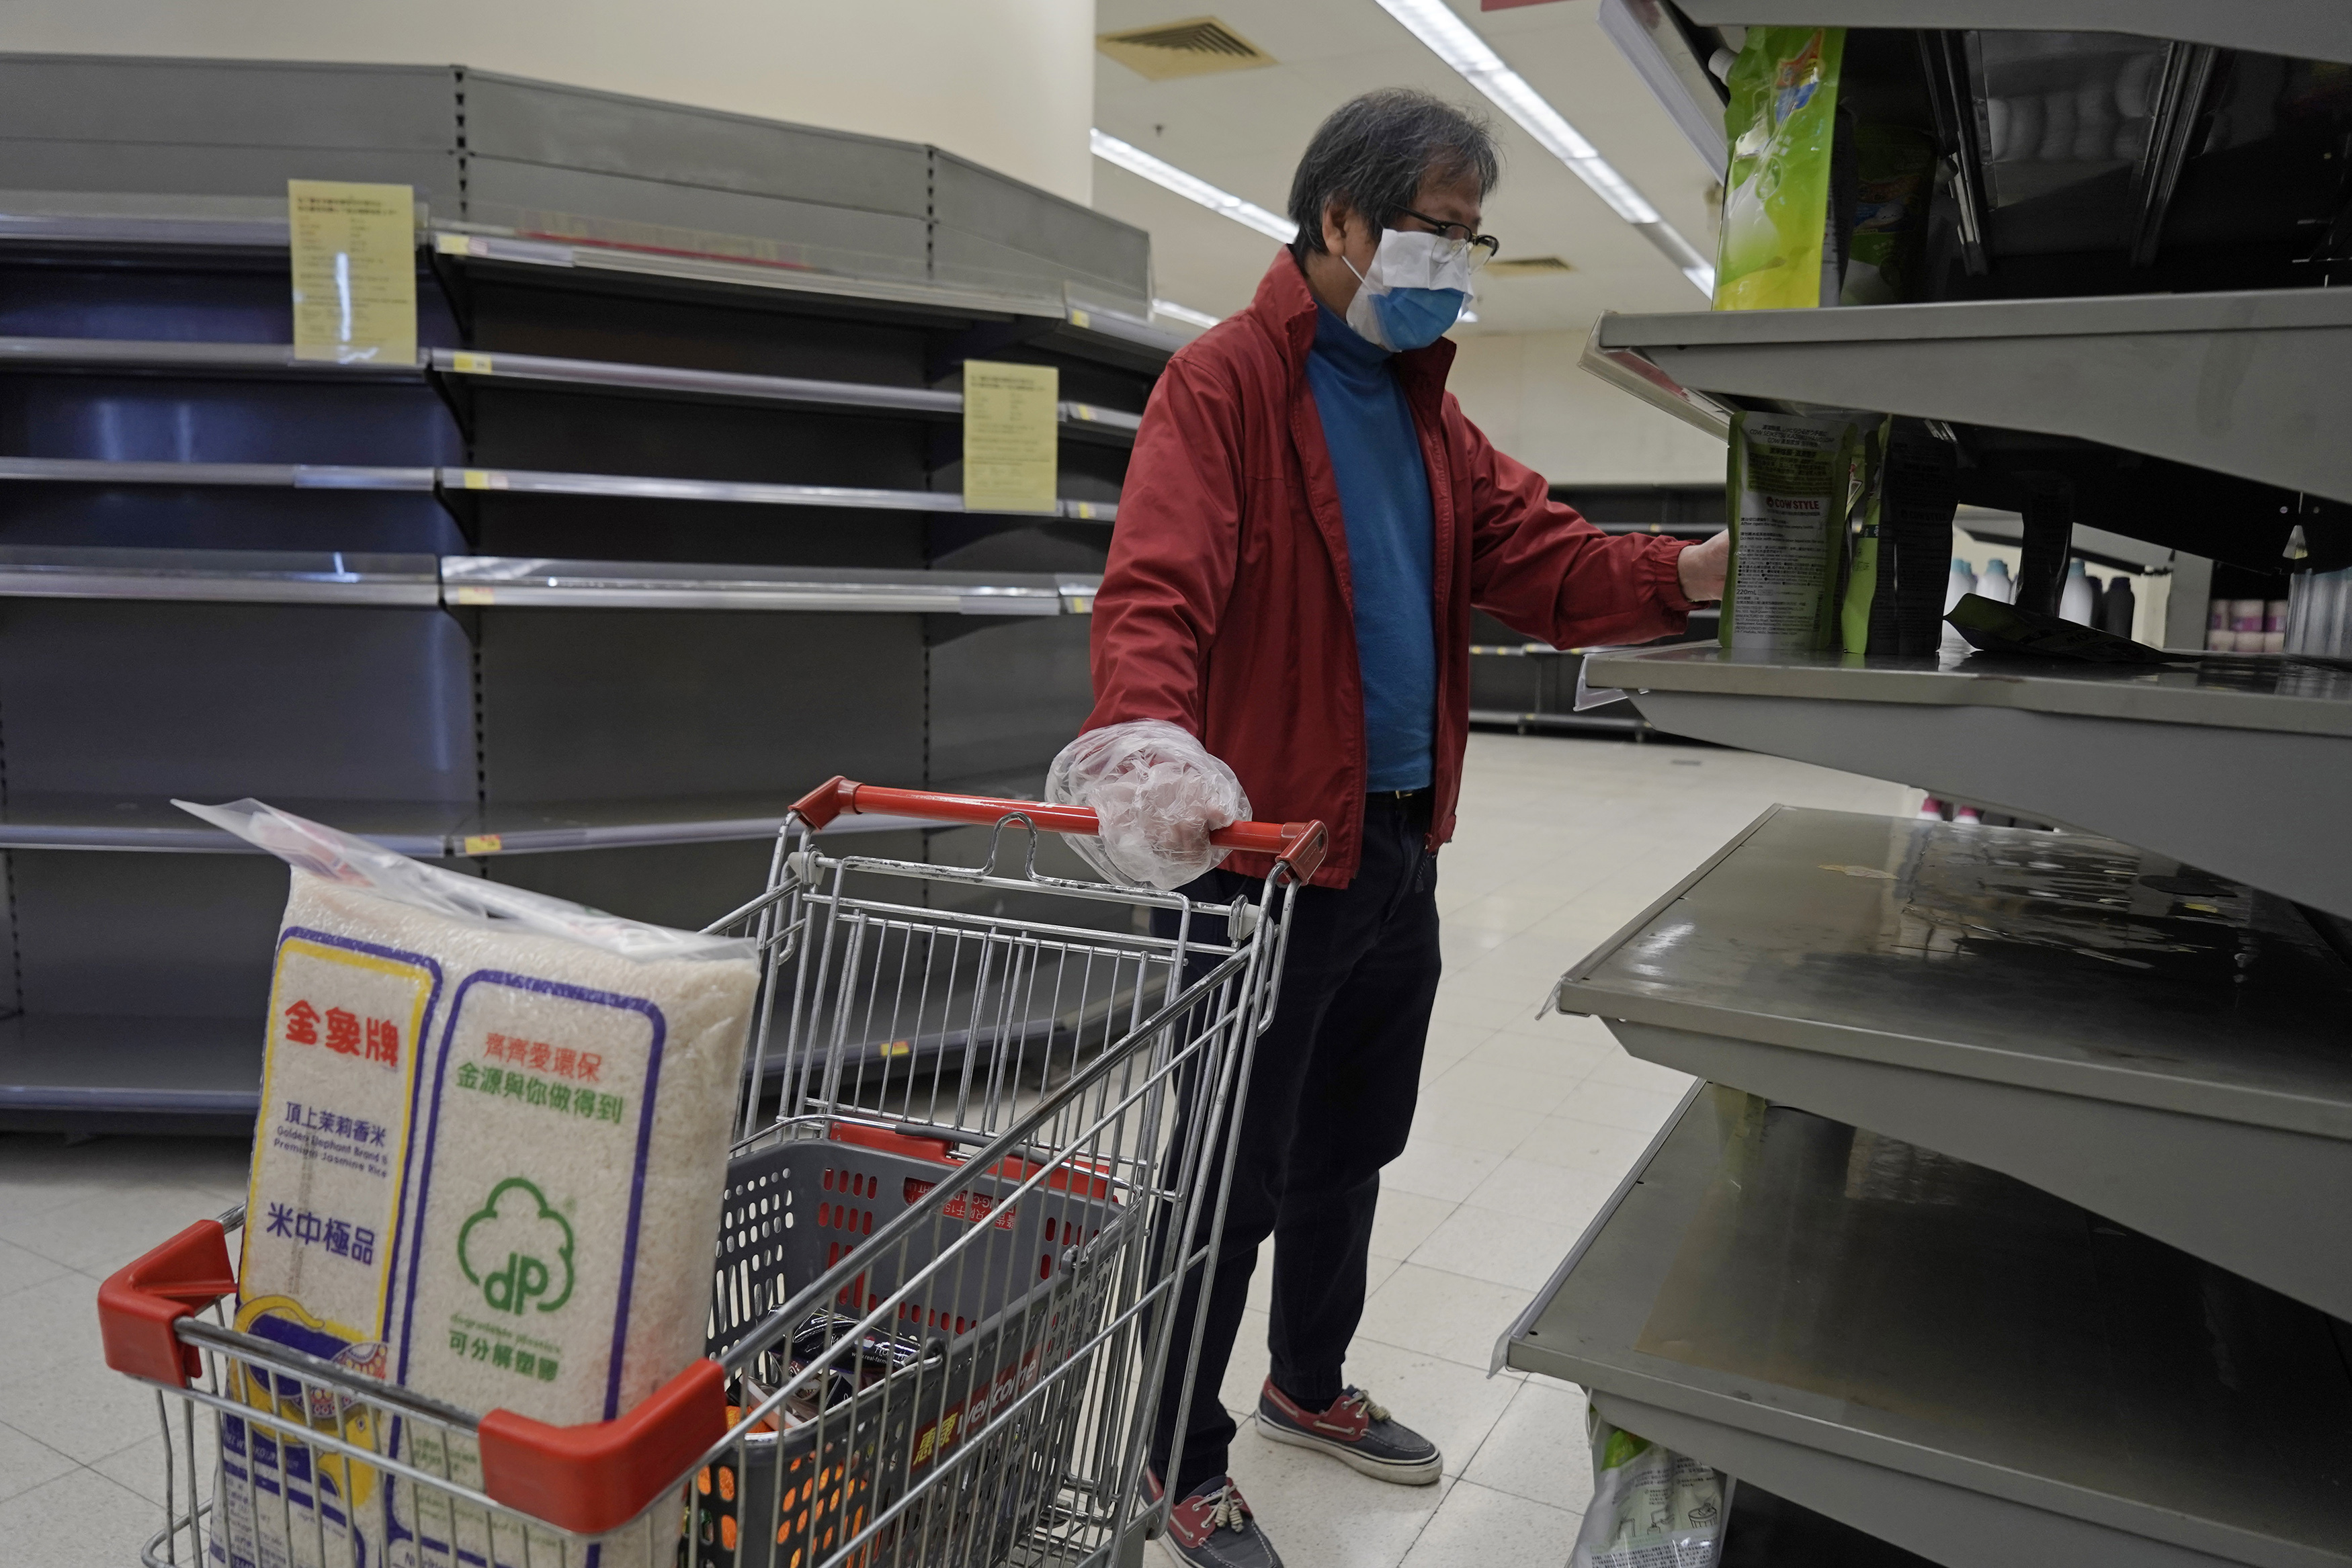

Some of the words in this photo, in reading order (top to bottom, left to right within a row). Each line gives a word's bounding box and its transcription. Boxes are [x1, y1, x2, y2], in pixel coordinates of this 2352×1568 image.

[1775, 498, 1792, 509] COW
[1793, 500, 1819, 510] STYLE
[277, 1126, 309, 1141] Golden
[274, 1137, 319, 1160] Premium
[321, 1152, 364, 1172] Jasmine
[368, 1164, 387, 1178] Rice
[266, 1202, 376, 1266] 米中極品
